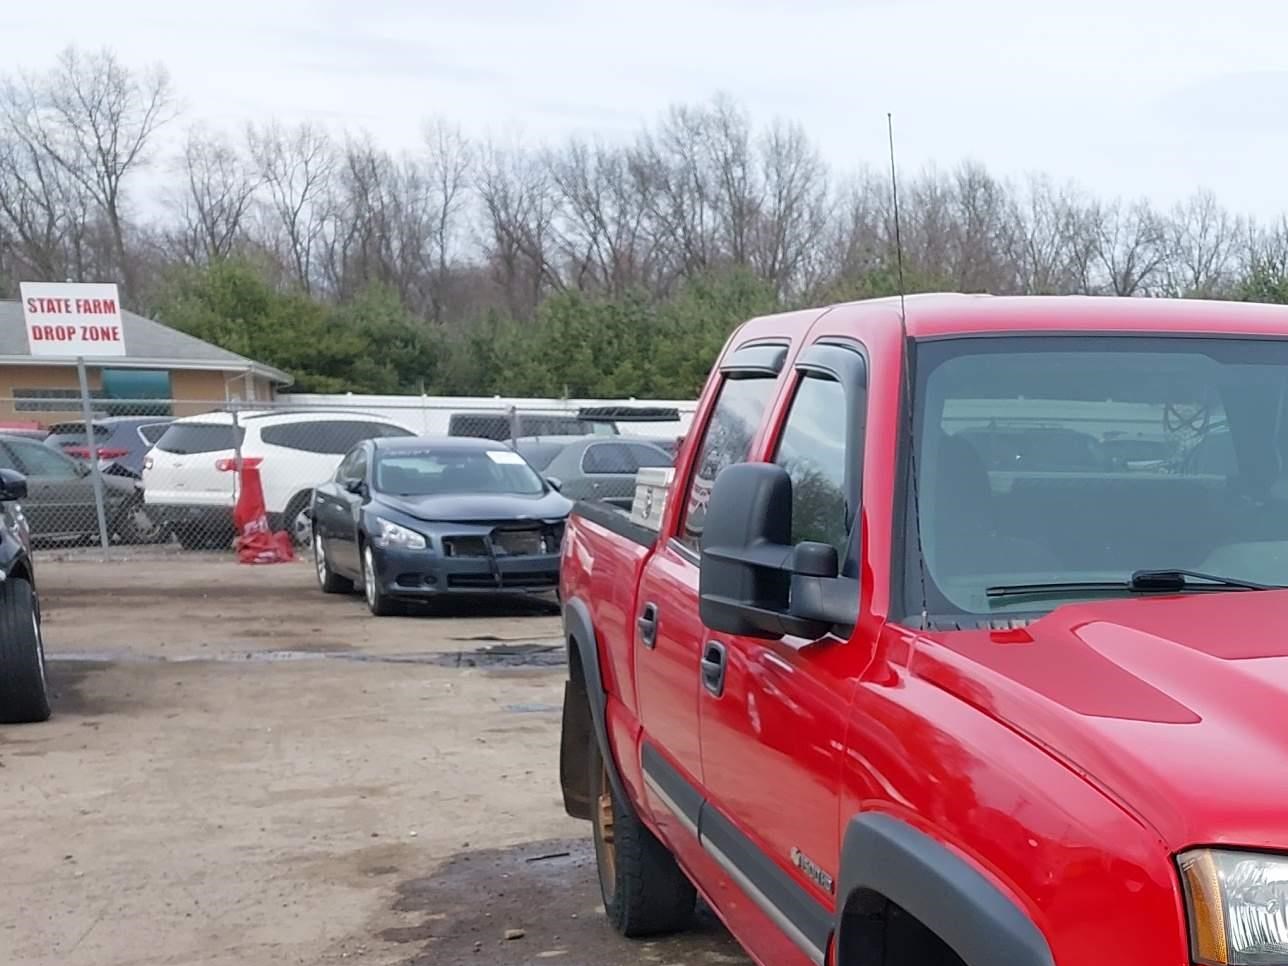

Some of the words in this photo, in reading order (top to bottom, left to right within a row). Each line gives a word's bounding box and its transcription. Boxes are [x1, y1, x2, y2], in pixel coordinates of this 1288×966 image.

[27, 298, 72, 314] STATE
[76, 298, 117, 315] FARM
[32, 325, 77, 342] DROP
[80, 326, 121, 342] ZONE
